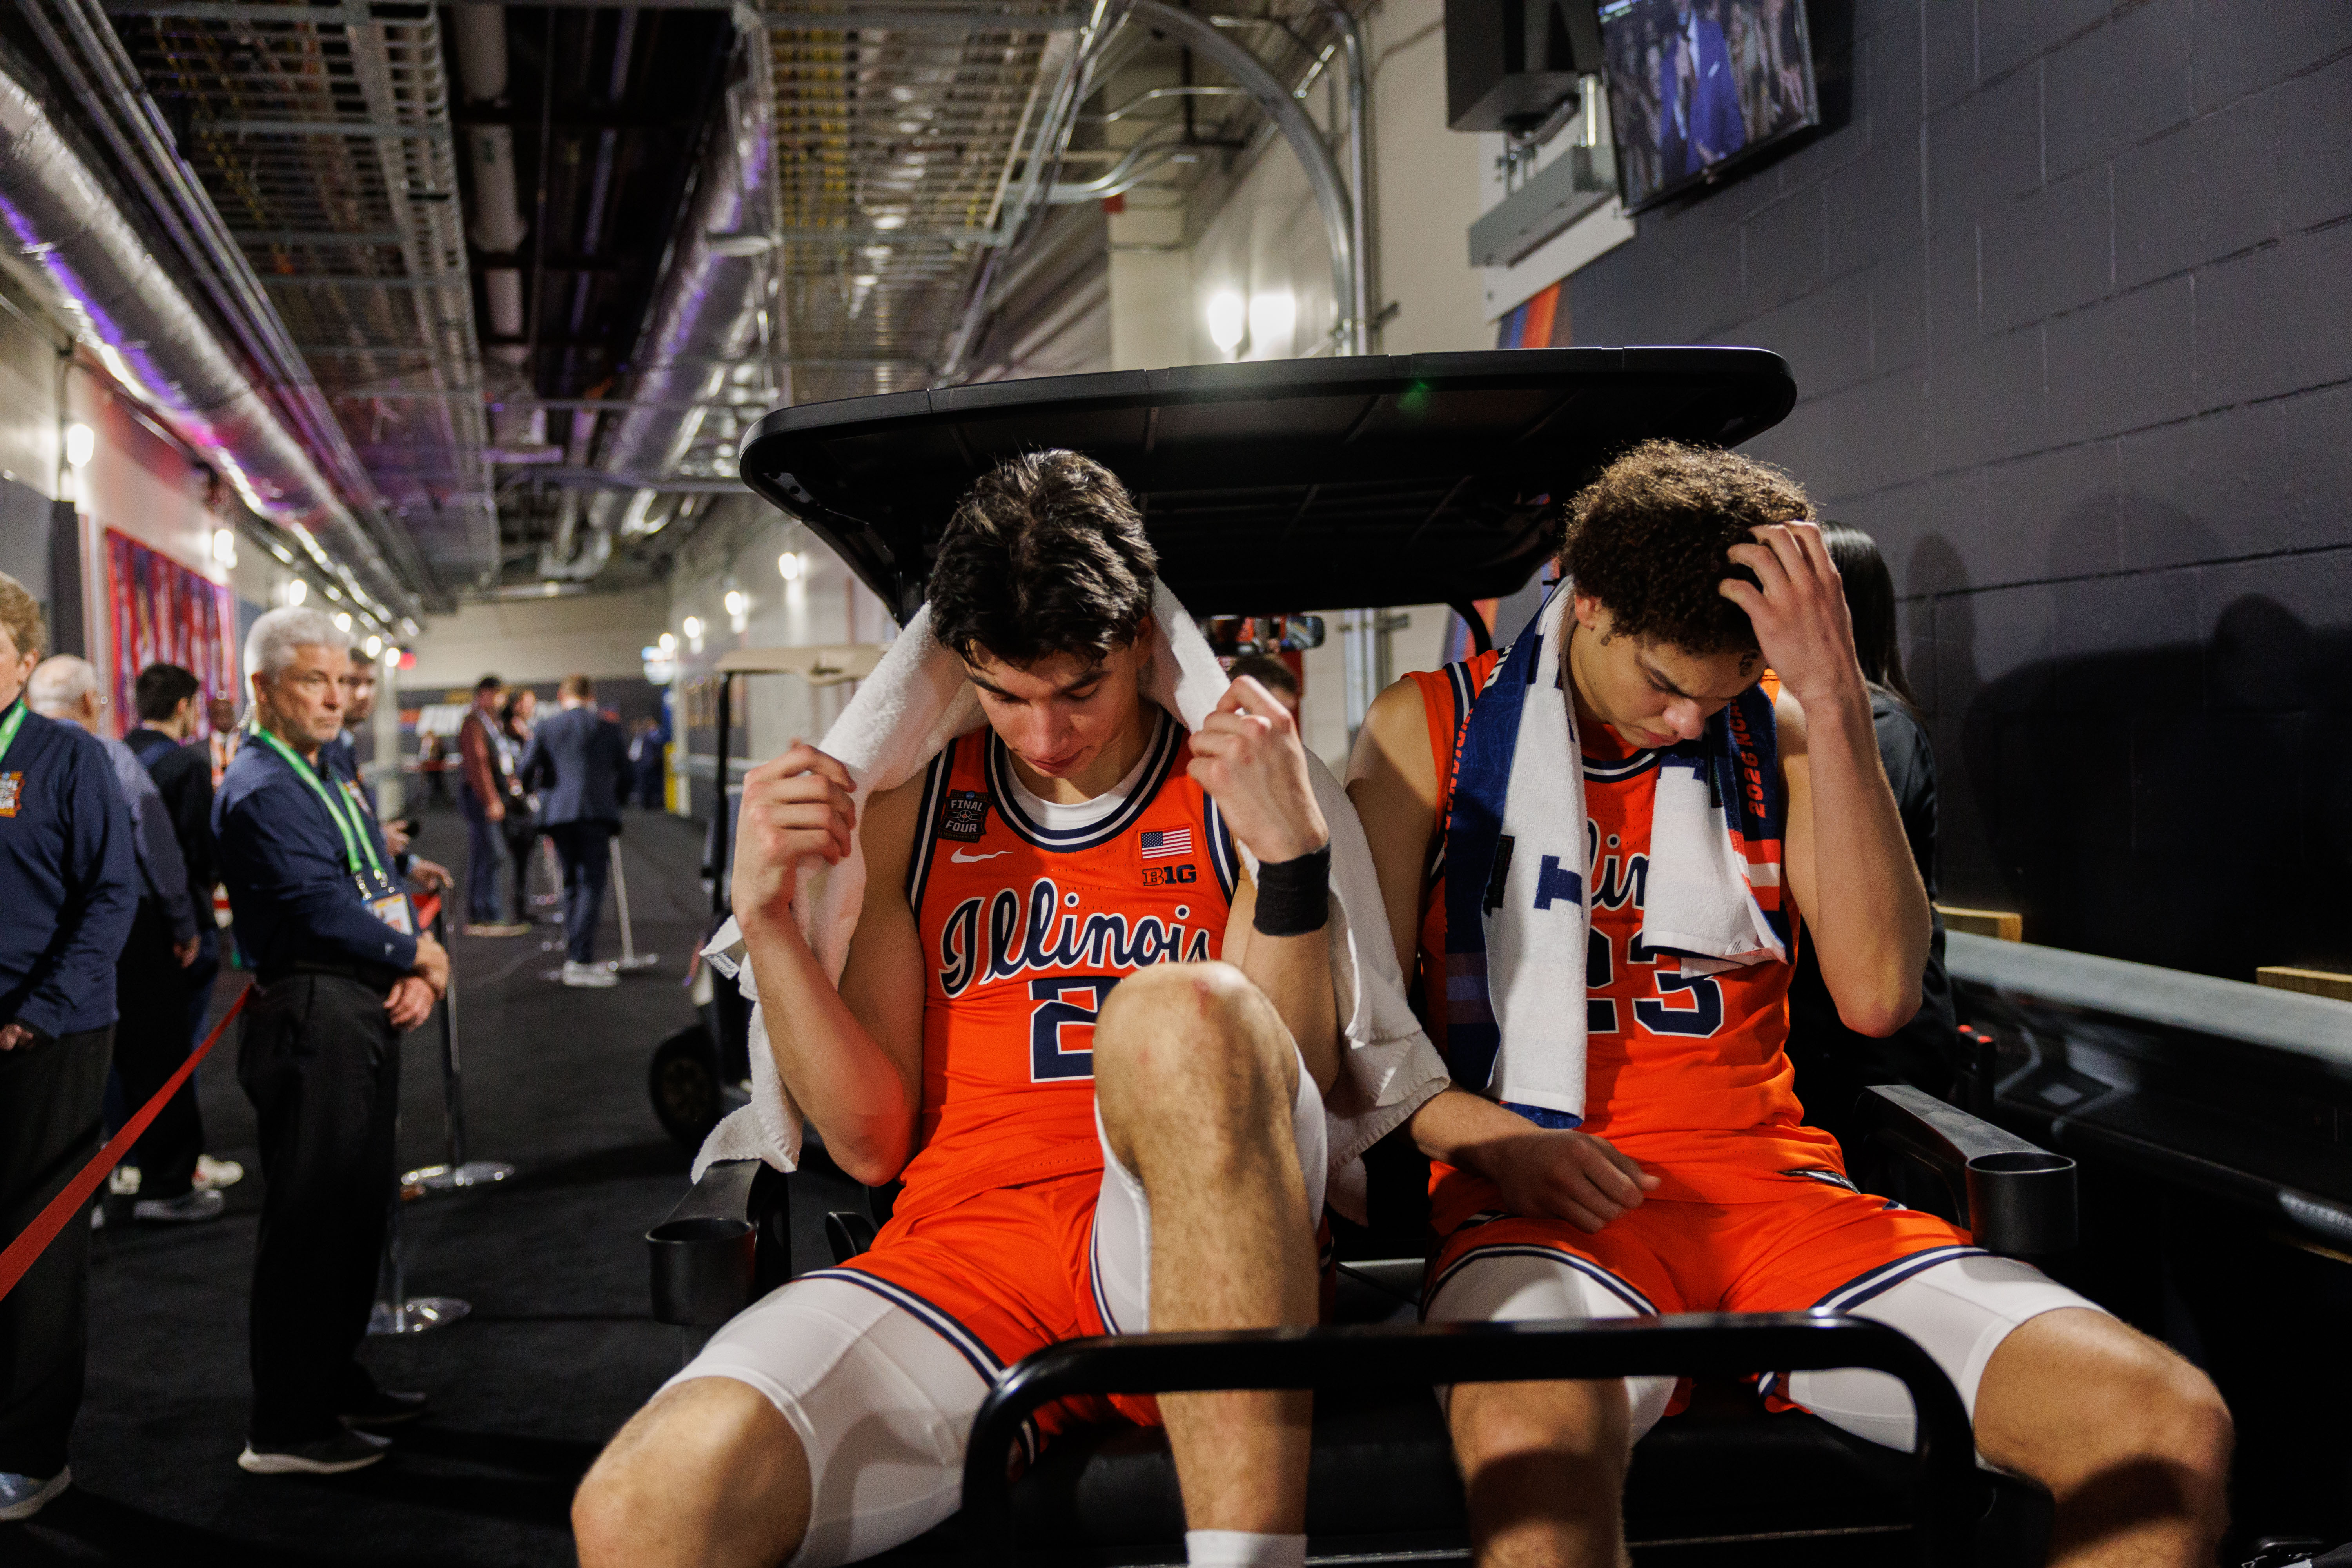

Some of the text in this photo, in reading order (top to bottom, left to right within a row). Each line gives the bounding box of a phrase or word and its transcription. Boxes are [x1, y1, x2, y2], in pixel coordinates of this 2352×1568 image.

[951, 800, 982, 811] FINAL
[1741, 751, 1766, 818] 2026
[945, 820, 977, 832] FOUR
[938, 877, 1210, 998] Illinois
[1028, 976, 1123, 1083] 2
